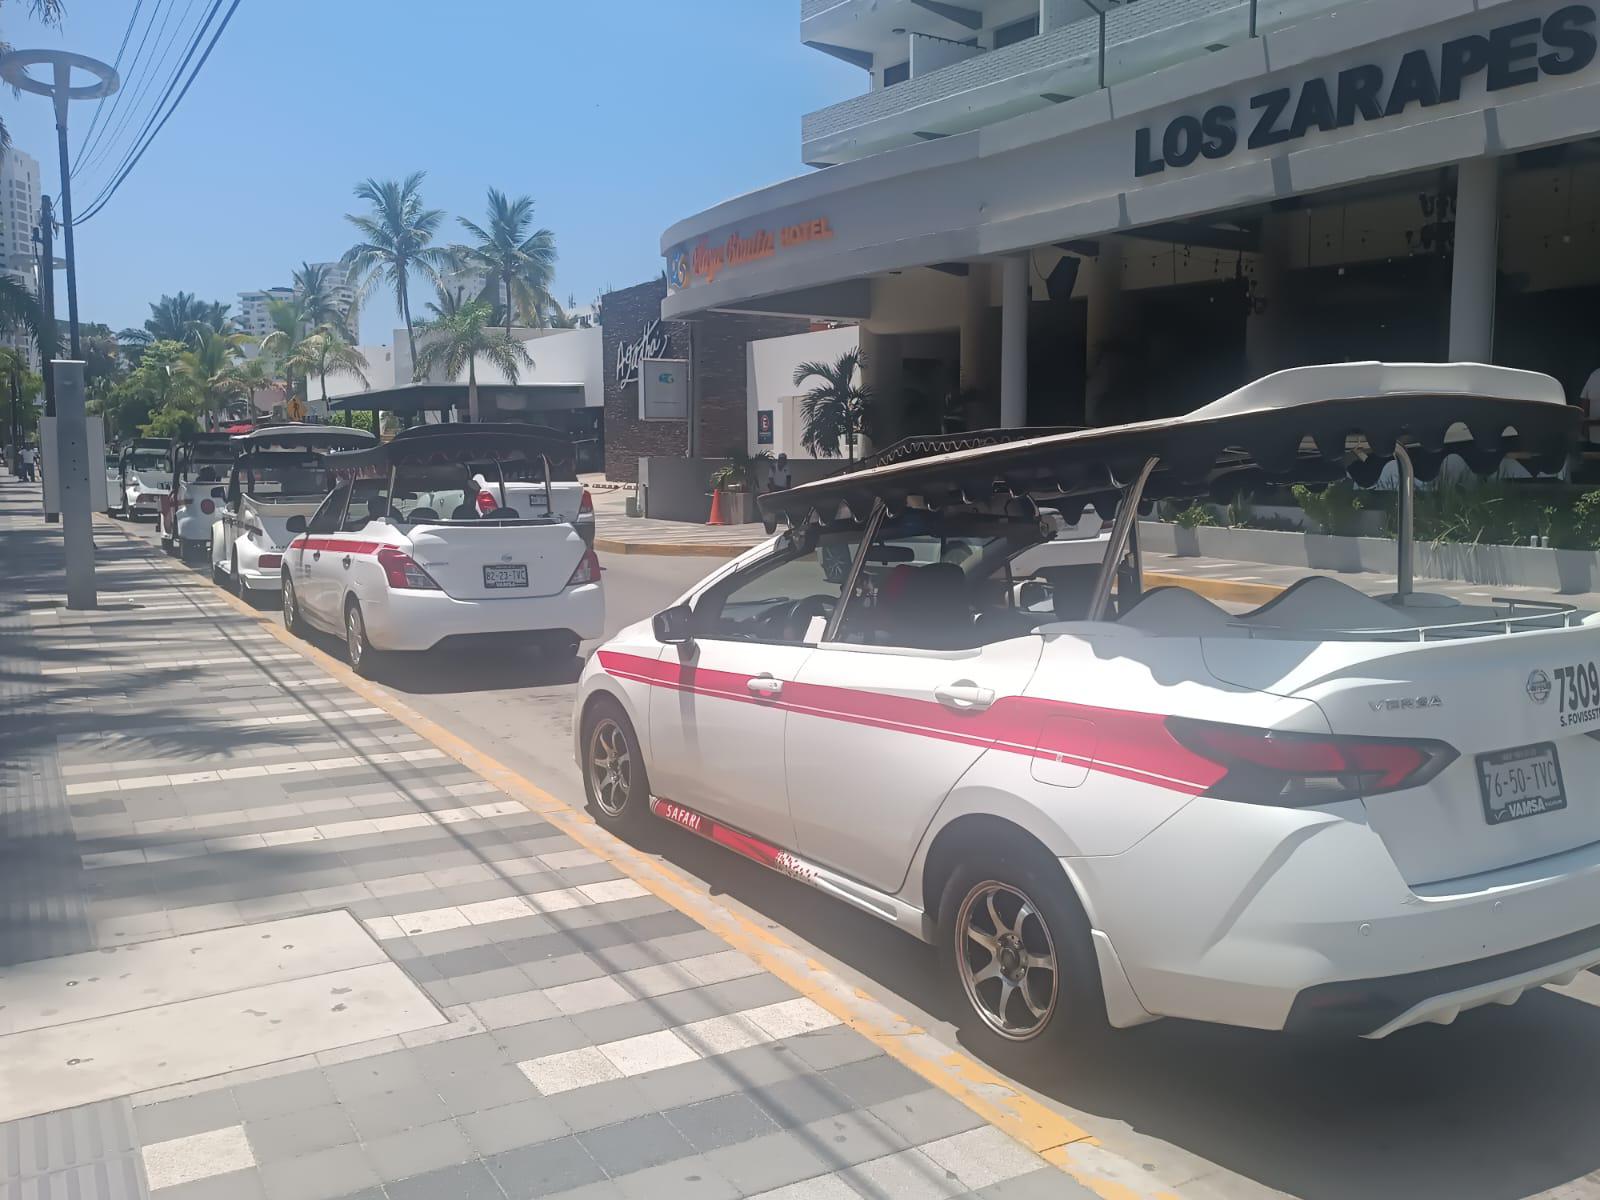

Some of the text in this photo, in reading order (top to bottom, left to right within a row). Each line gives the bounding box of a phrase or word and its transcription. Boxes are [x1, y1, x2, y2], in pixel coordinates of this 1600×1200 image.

[1135, 4, 1598, 178] LOS ZARAPES
[781, 216, 833, 248] HOTEL
[1553, 661, 1600, 713] 7309
[1367, 695, 1443, 712] VERSA
[665, 804, 701, 830] SAFARI
[1508, 798, 1546, 818] VAMSA
